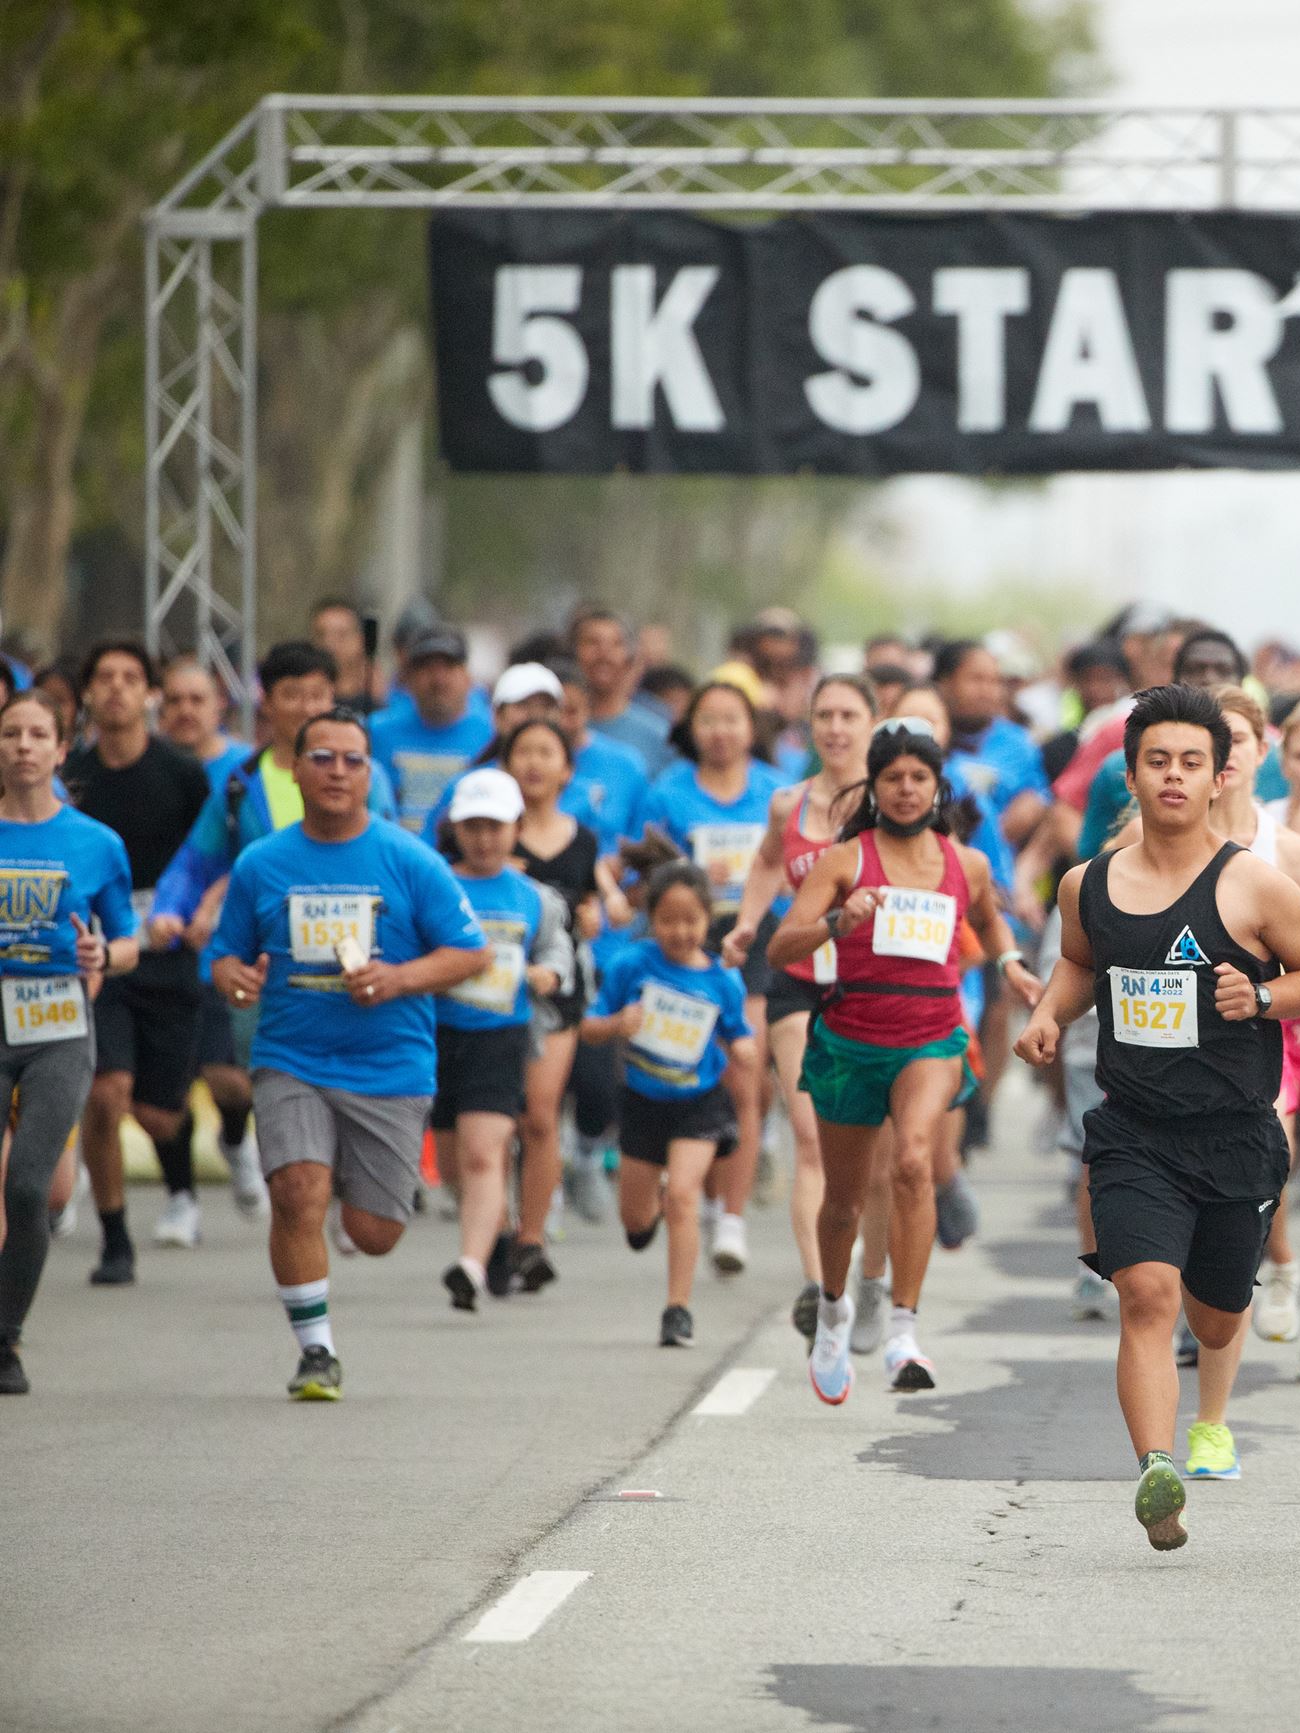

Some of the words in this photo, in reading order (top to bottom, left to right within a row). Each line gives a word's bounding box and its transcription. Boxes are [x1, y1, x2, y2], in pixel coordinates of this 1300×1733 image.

[486, 264, 727, 434] 5K
[887, 914, 948, 945] 1330
[1150, 978, 1161, 995] 4
[1162, 978, 1183, 988] JUN
[1119, 998, 1186, 1030] 1527
